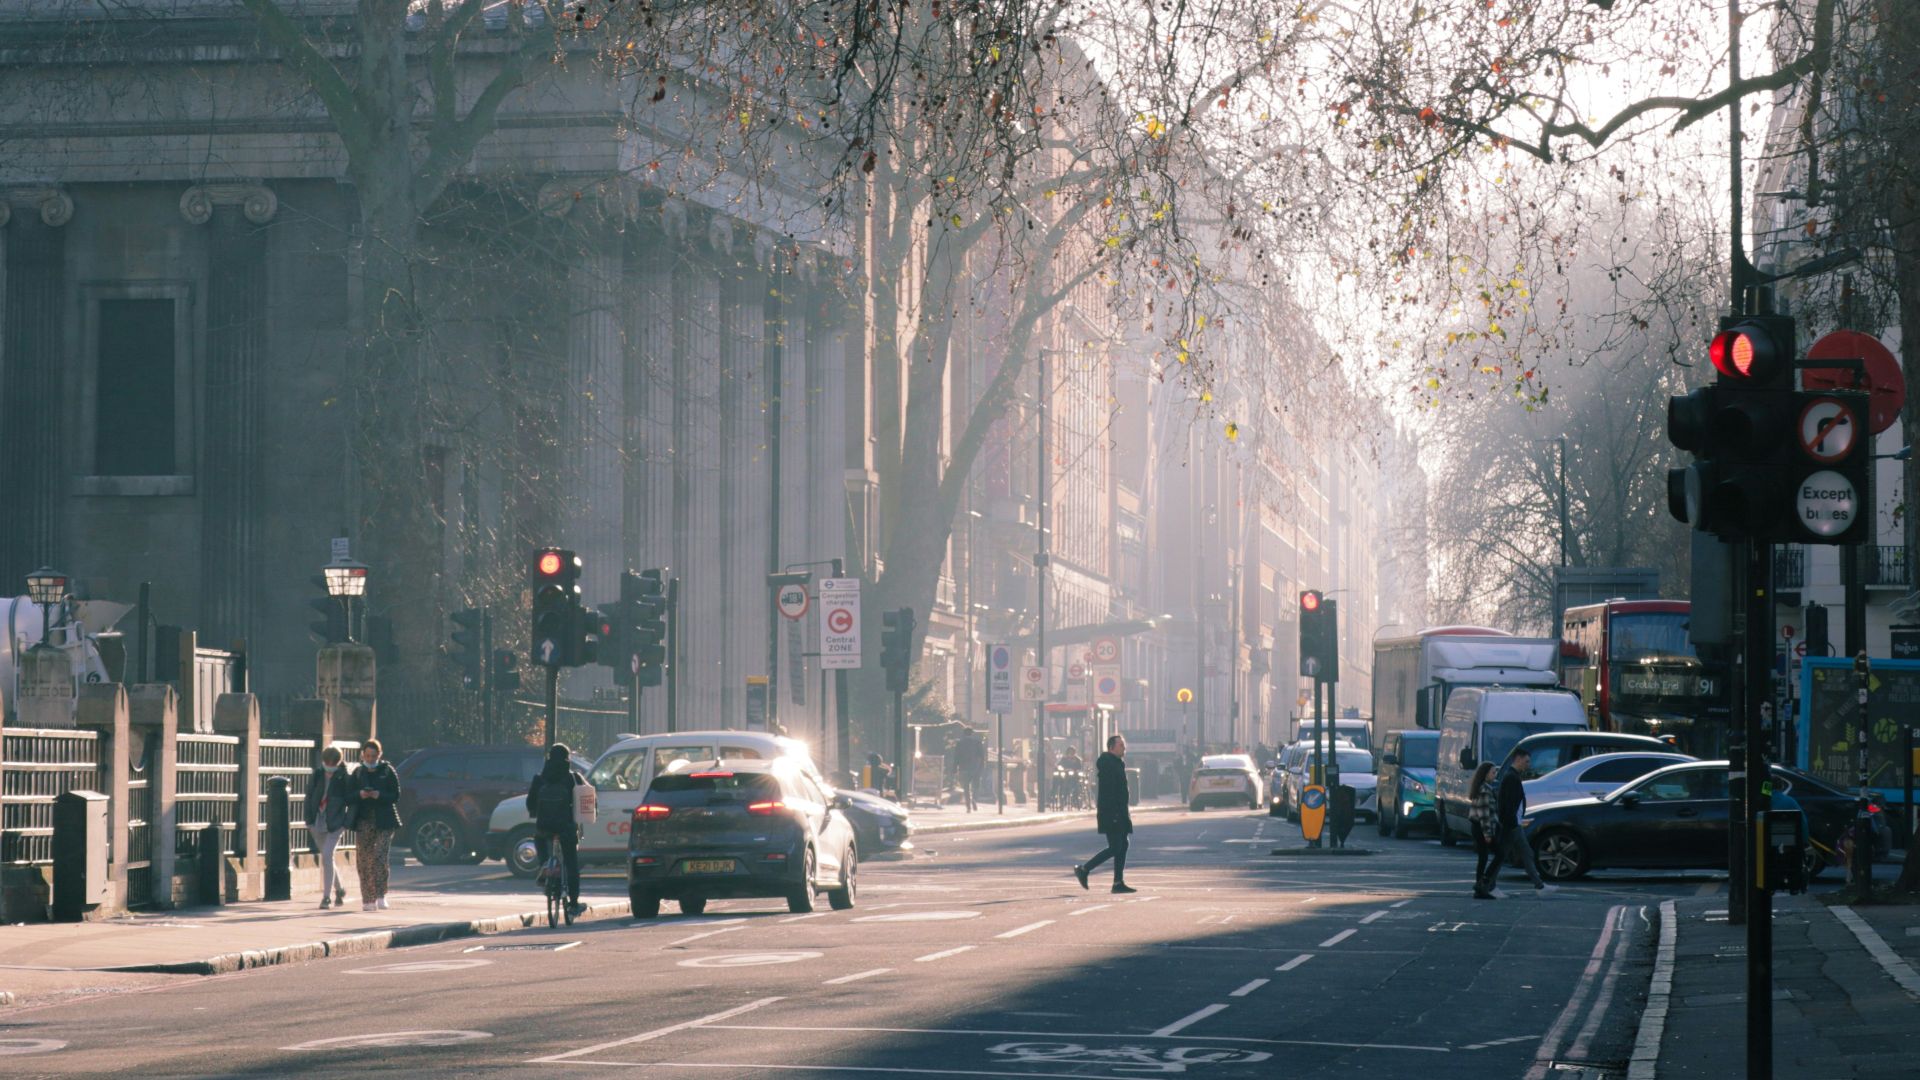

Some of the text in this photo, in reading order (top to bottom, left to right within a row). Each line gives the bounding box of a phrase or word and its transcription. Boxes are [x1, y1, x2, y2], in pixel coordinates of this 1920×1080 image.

[1803, 486, 1852, 502] Except
[1806, 506, 1848, 520] bes
[828, 644, 853, 652] ZONE
[1100, 645, 1114, 655] 20
[1628, 680, 1713, 694] Crouch End 91
